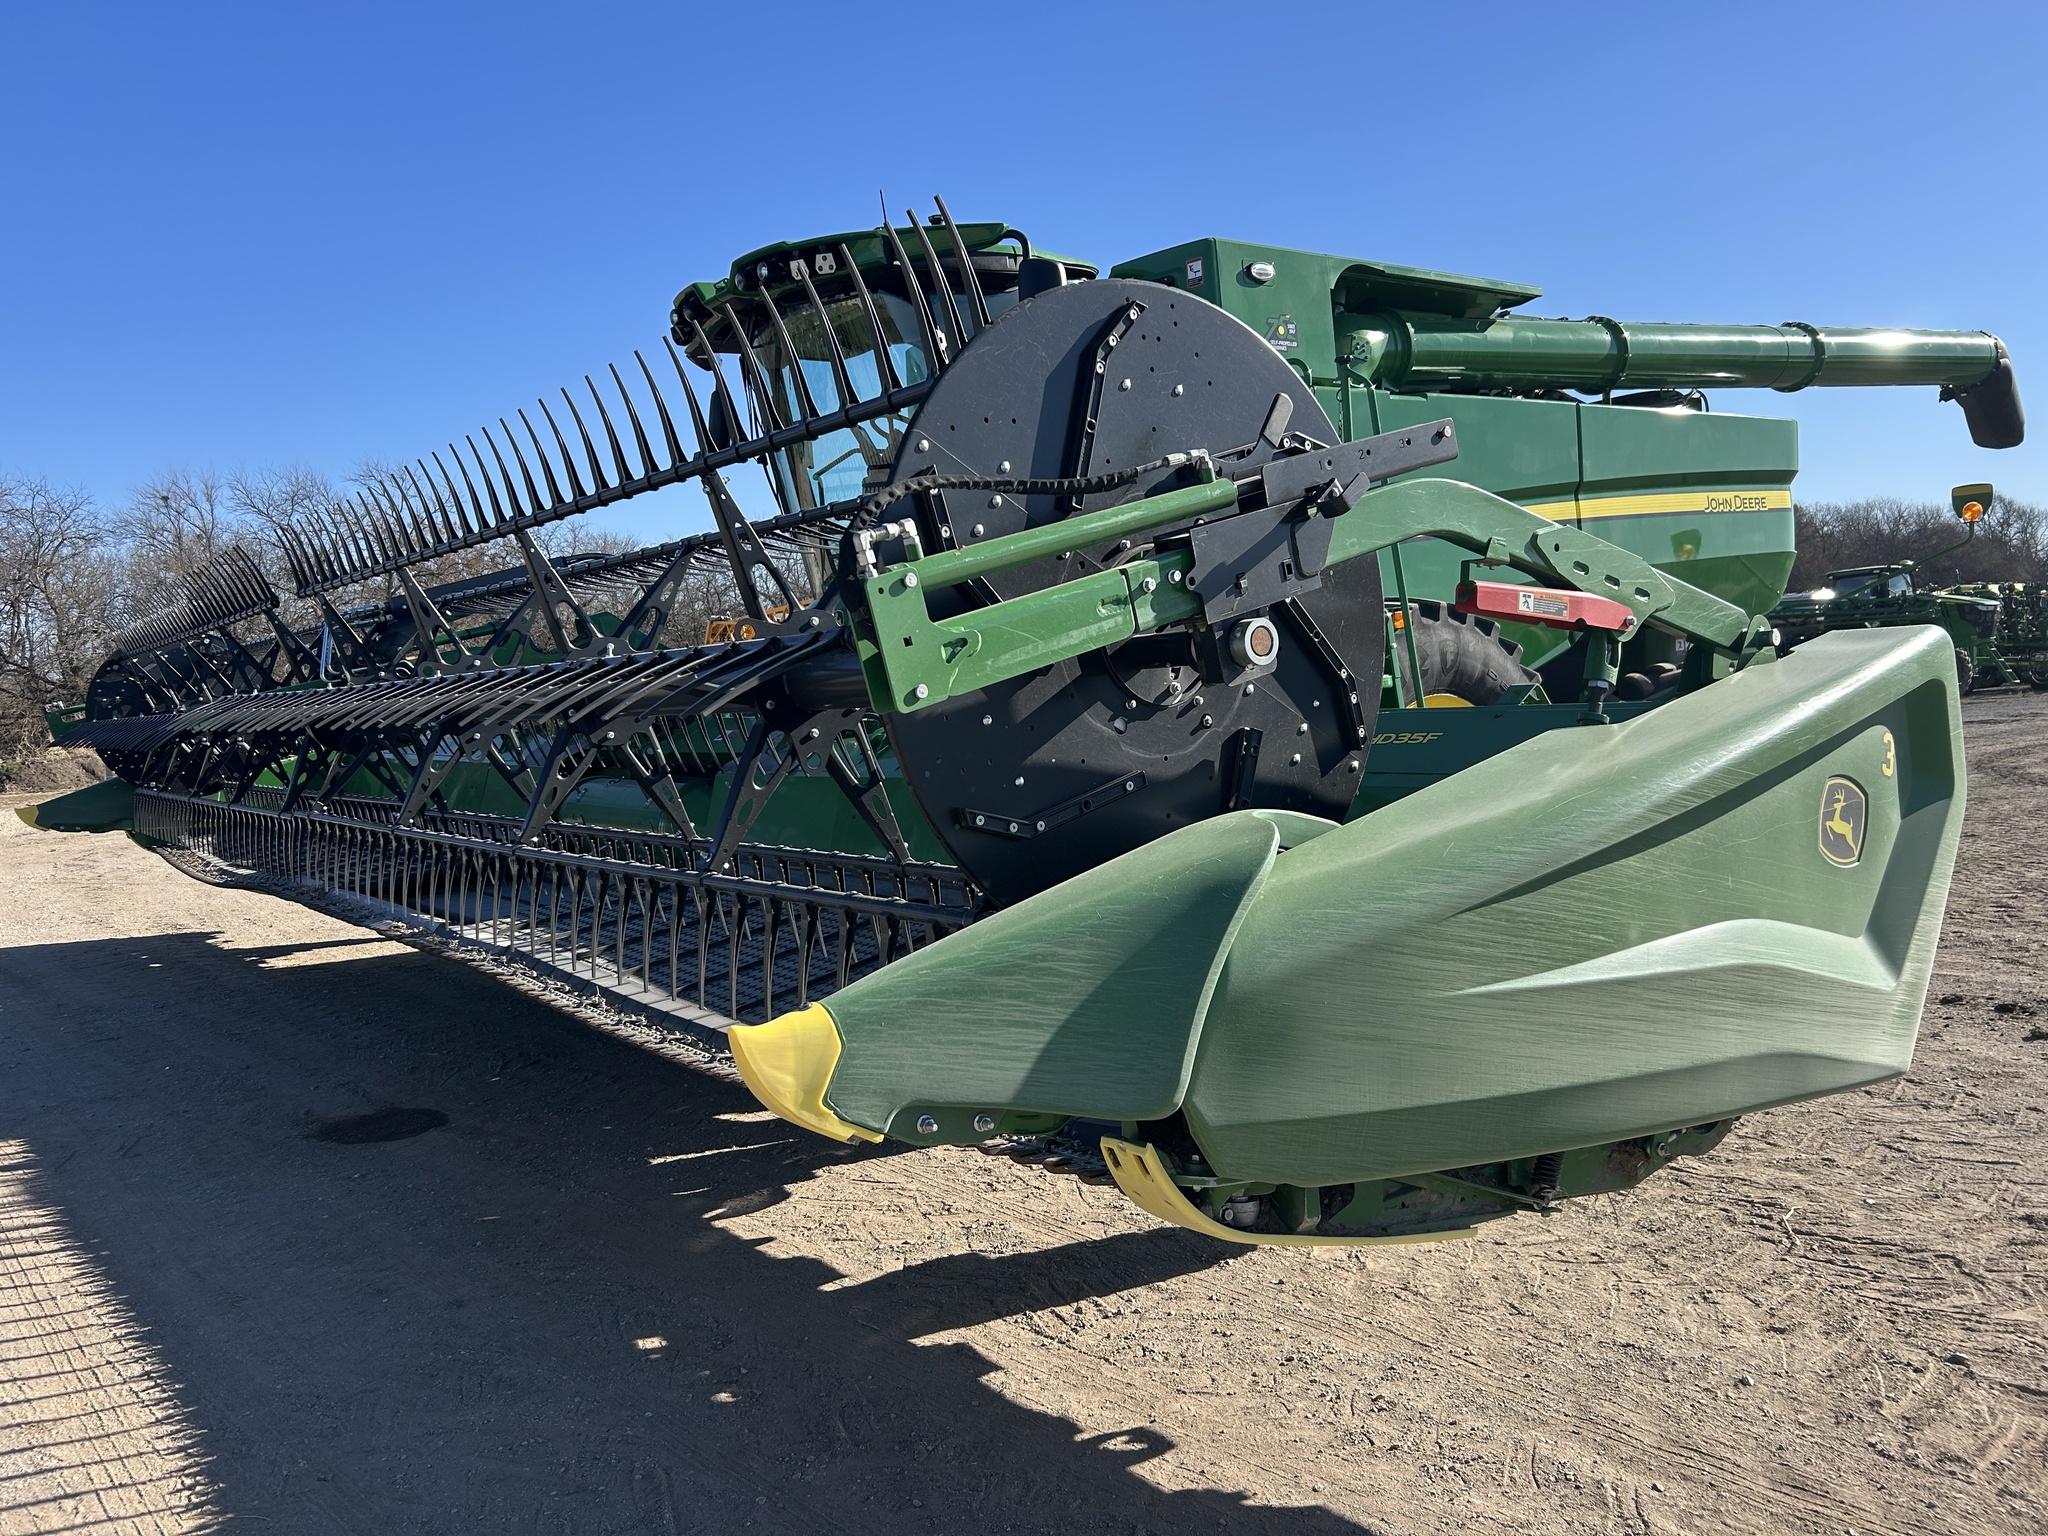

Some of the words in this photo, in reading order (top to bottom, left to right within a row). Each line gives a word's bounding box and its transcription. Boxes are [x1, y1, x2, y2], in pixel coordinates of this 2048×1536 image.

[1357, 449, 1365, 460] 2
[1398, 438, 1405, 448] 3
[1704, 495, 1733, 511] JOHN
[1734, 495, 1767, 510] DEERE
[1882, 732, 1896, 777] 3
